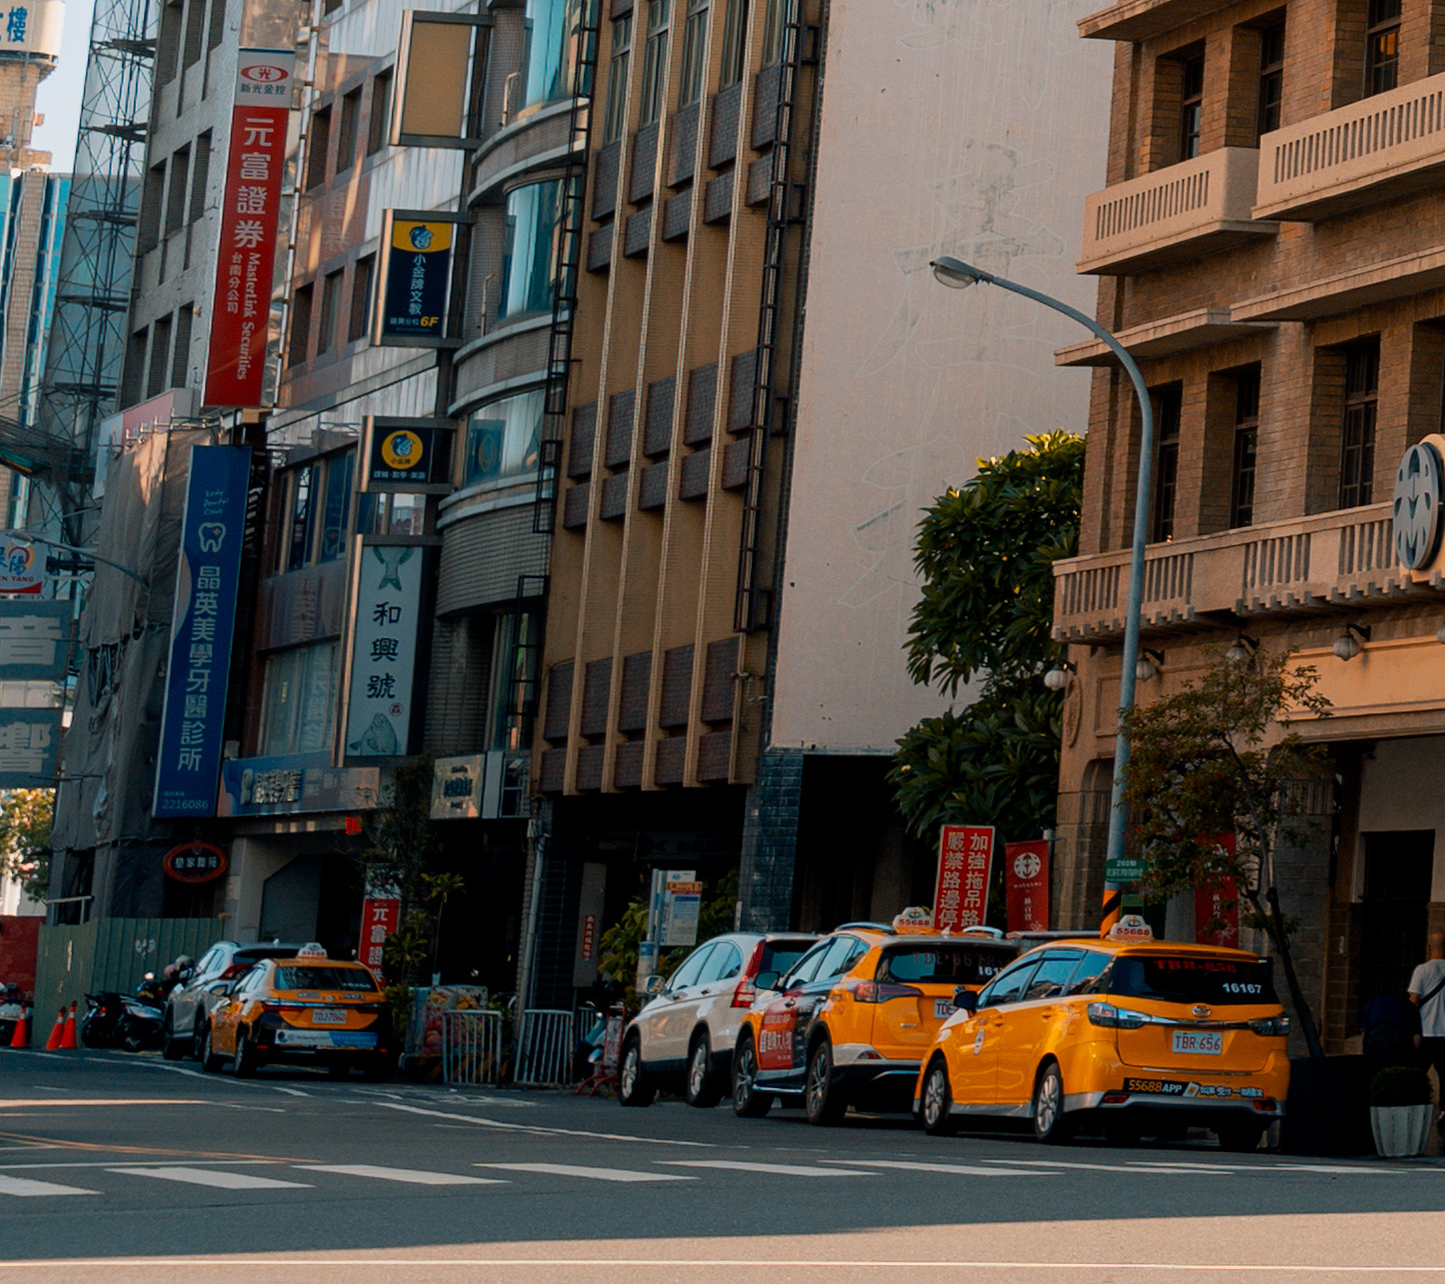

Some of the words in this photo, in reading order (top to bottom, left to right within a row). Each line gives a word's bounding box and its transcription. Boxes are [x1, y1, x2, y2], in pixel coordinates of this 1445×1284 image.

[0, 5, 28, 43] 樓
[240, 82, 287, 96] 新光金控
[234, 117, 275, 249] 元富證券
[227, 252, 243, 314] 台南分公司
[243, 252, 262, 318] MasterLink
[237, 321, 255, 380] Securities
[420, 316, 439, 327] 6F
[177, 565, 221, 773] 晶英美學牙醫診所
[366, 601, 402, 699] 和興號
[162, 798, 209, 810] 2216086
[961, 832, 989, 927] 加強拖吊路
[1116, 928, 1150, 936] 55688
[1222, 982, 1263, 995] 16167
